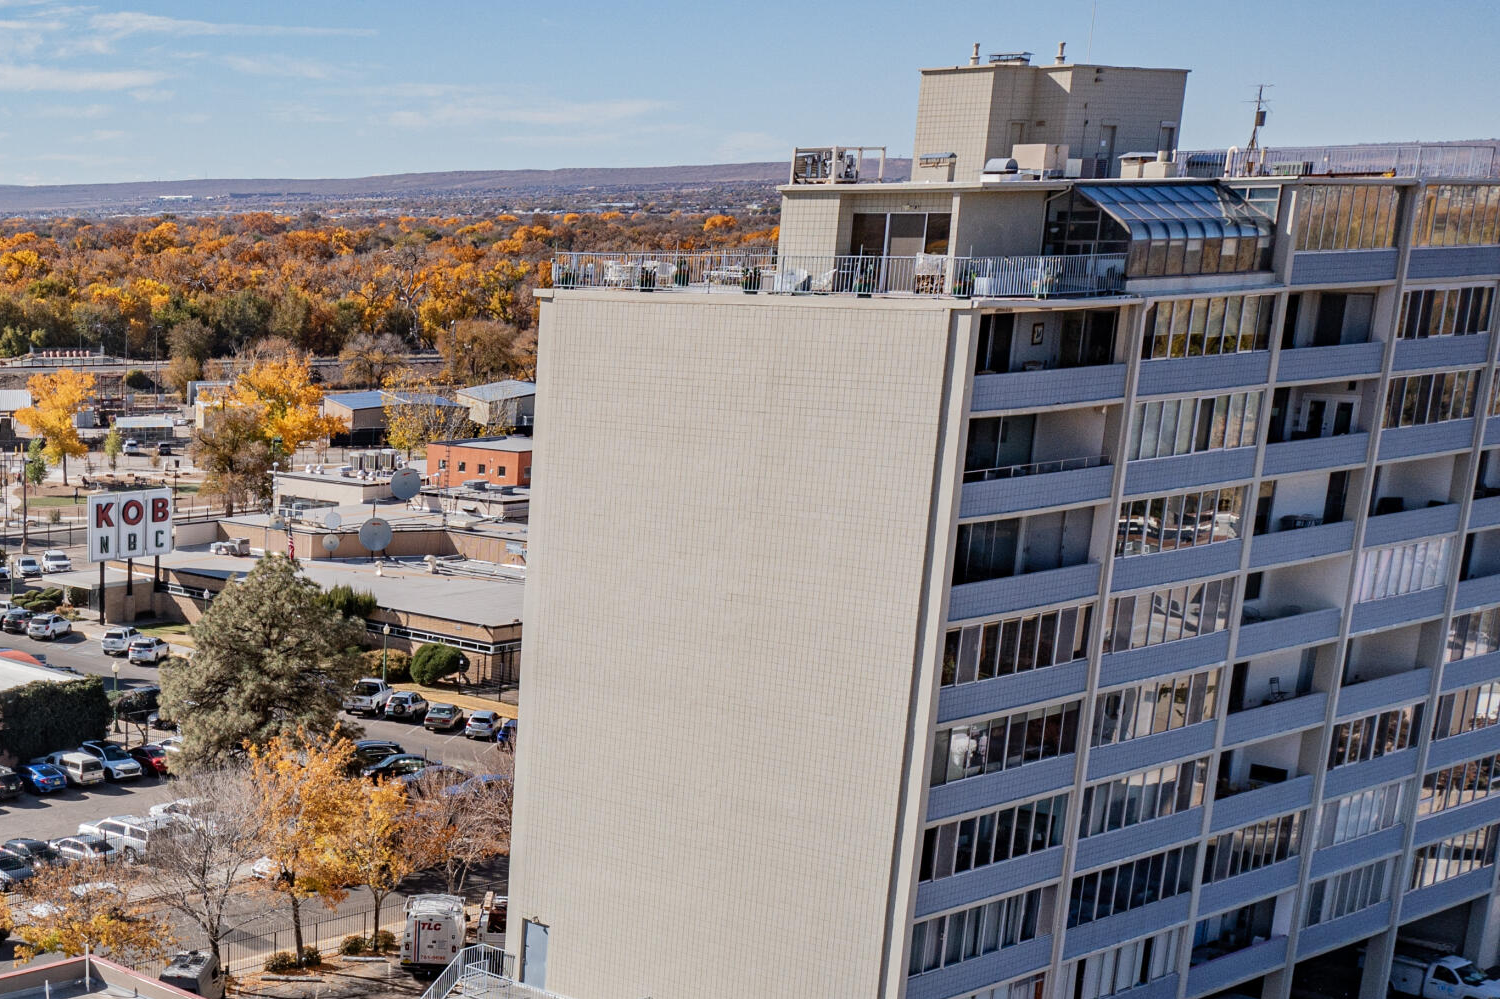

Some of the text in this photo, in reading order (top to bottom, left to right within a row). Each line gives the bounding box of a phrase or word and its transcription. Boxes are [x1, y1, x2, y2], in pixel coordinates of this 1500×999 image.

[95, 498, 170, 529] KOB
[100, 530, 165, 554] NBC
[420, 922, 442, 931] TLC
